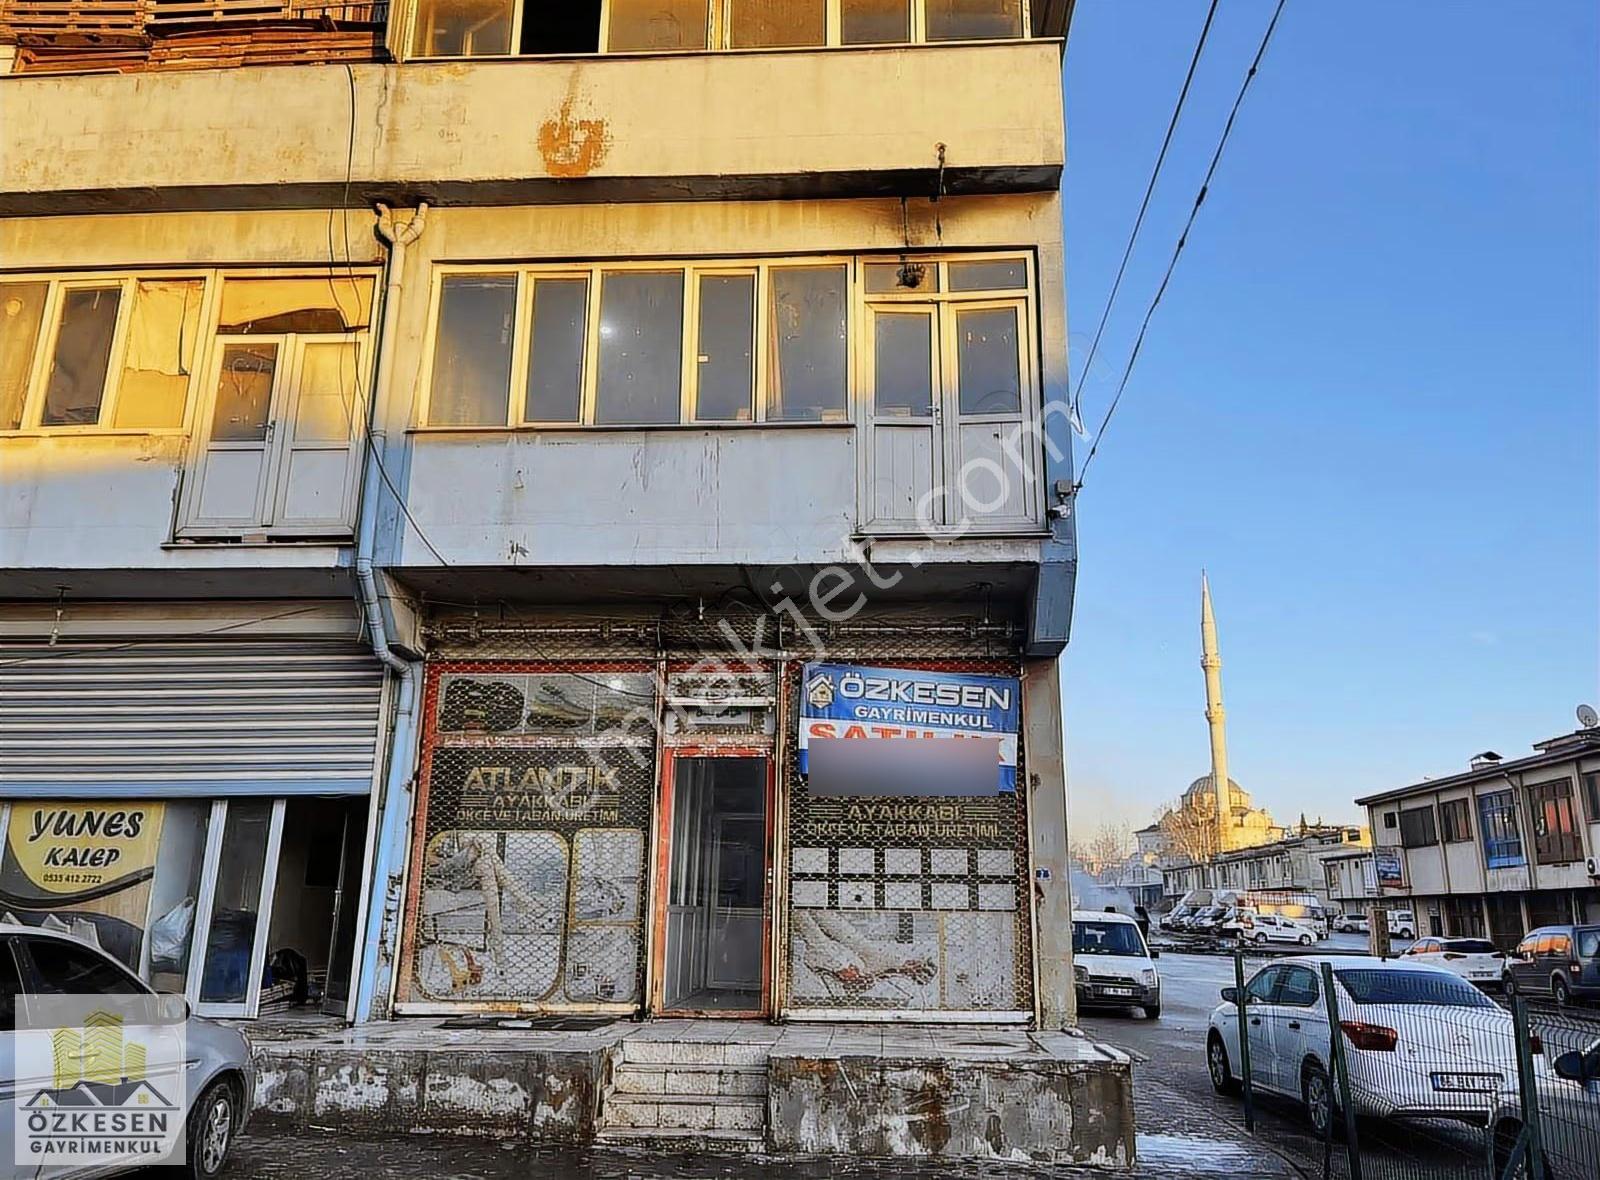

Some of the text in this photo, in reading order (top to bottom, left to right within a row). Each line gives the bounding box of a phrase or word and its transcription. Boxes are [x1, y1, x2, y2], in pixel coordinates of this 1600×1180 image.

[839, 672, 1011, 711] ÖZKESEN
[854, 705, 994, 729] GAYRİMENKUL
[492, 795, 589, 808] AYAKKABI
[850, 804, 960, 820] AYAKKABI
